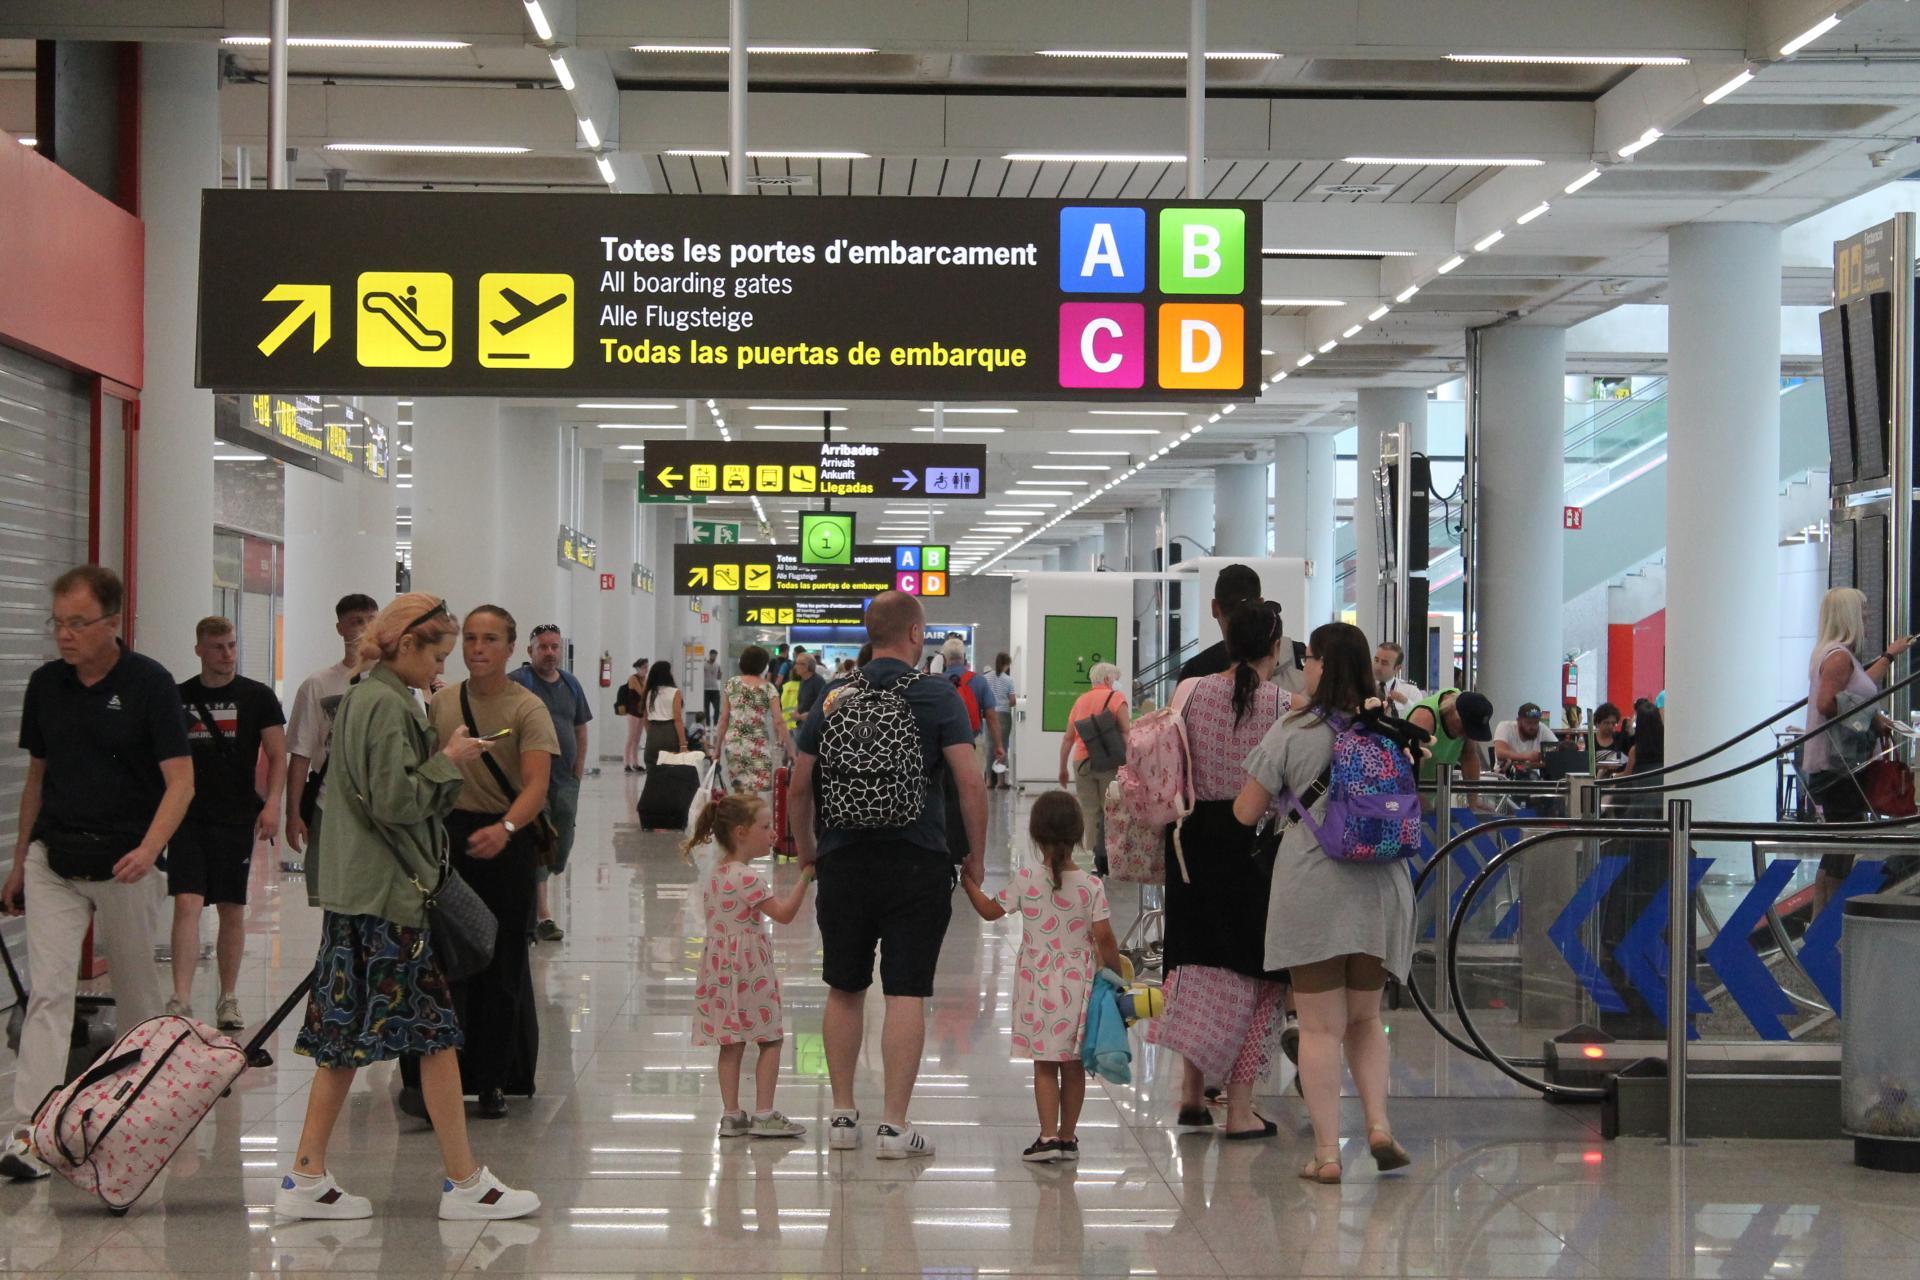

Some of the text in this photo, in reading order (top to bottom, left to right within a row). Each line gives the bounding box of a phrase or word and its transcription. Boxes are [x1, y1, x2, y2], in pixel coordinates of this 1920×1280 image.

[600, 236, 1038, 269] Totes les portes d'embarcament
[1080, 223, 1222, 278] A B
[600, 270, 793, 299] All boarding gates
[600, 304, 754, 332] Alle Flugsteige
[1080, 317, 1222, 373] C D
[600, 338, 1027, 372] Todas las puertas de embarque
[821, 444, 880, 456] Arribades
[820, 458, 855, 468] Arrivals
[820, 469, 855, 480] Ankunft
[820, 481, 874, 495] Llegadas
[776, 555, 891, 564] Totes arcament
[901, 551, 940, 566] A B
[776, 581, 889, 592] Todas las puertas de embarque
[901, 575, 940, 592] C D
